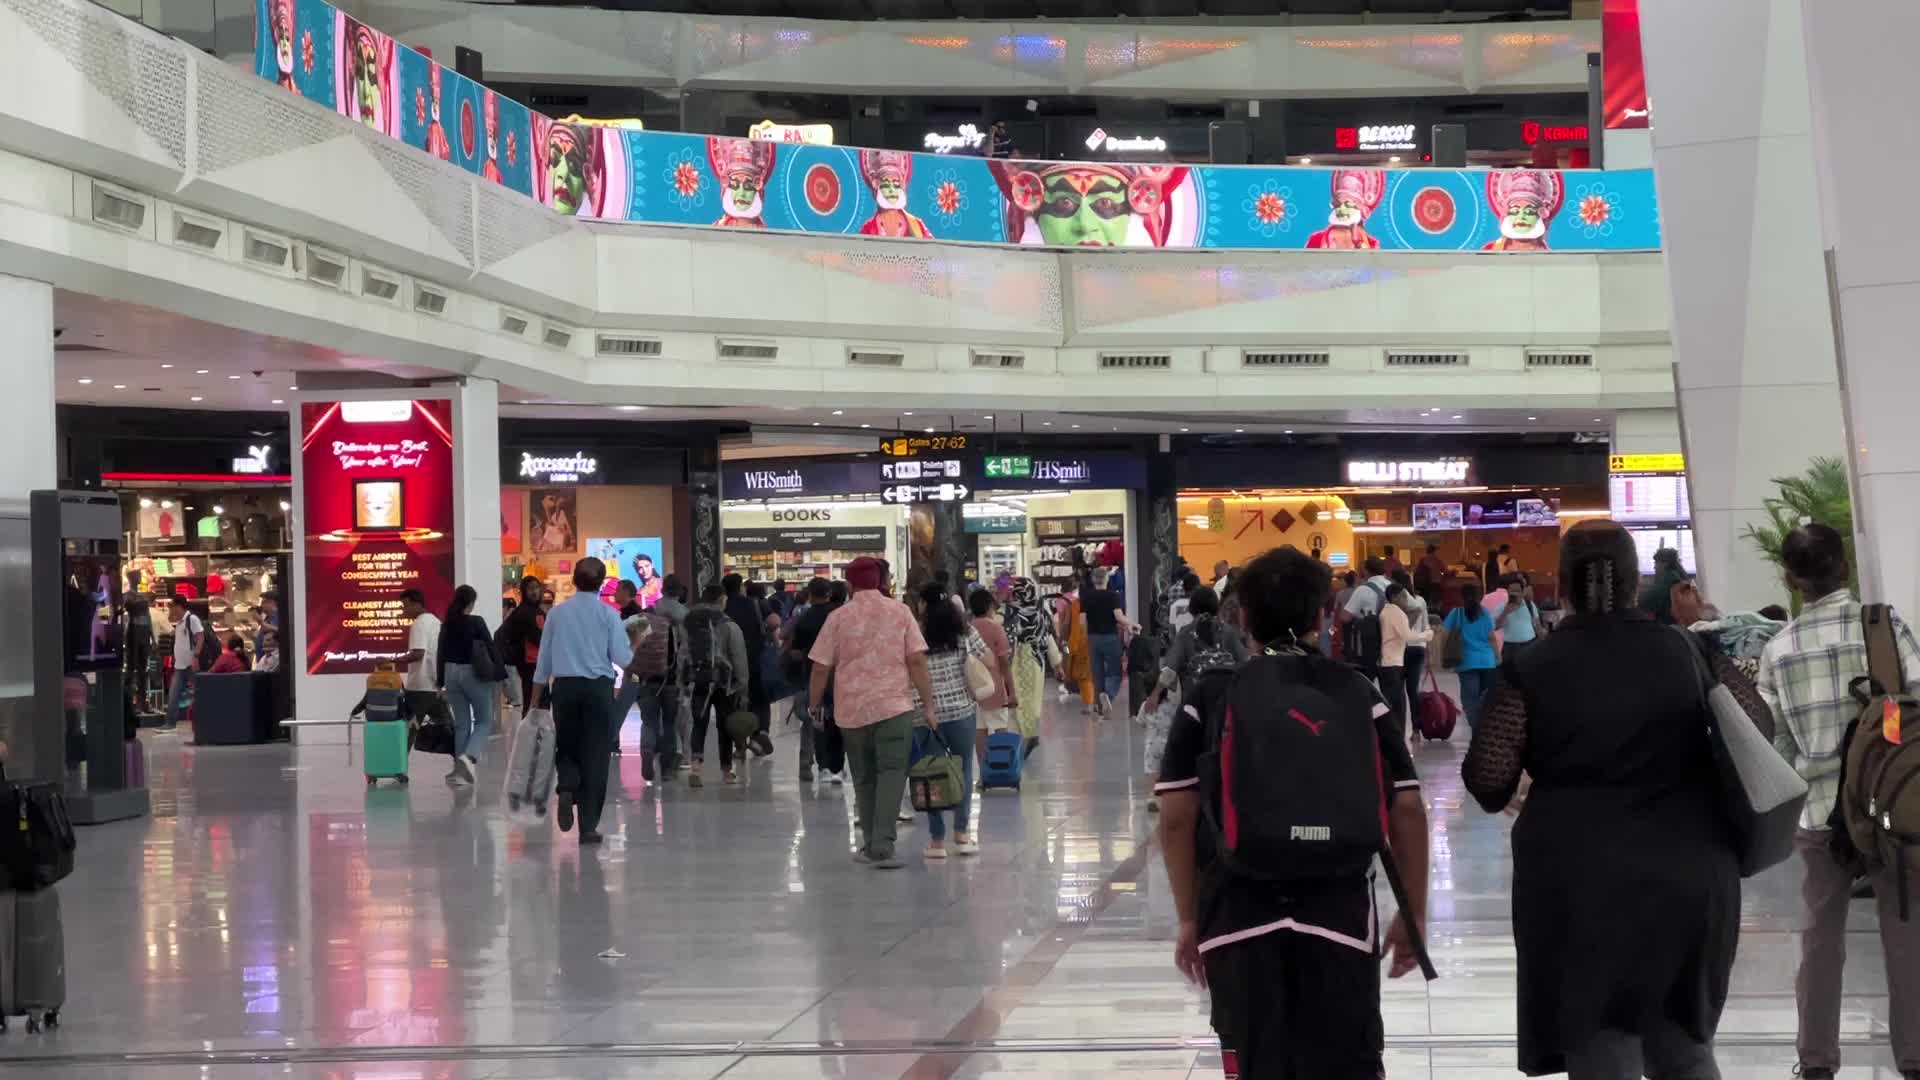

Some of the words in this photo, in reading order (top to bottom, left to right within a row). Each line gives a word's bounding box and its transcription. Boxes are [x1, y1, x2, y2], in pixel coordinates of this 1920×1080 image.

[909, 438, 930, 447] Gates
[520, 451, 596, 477] Accessorize
[1014, 457, 1028, 466] Exit
[744, 469, 803, 489] WHSmith
[772, 509, 832, 522] BOOKS
[352, 552, 372, 561] BEST
[373, 552, 408, 561] AIRPORT
[375, 562, 391, 570] THE
[341, 571, 396, 580] CONSECUTIVE
[398, 570, 419, 579] YEAR
[343, 601, 382, 609] CLEANEST
[1290, 826, 1331, 841] PUMA
